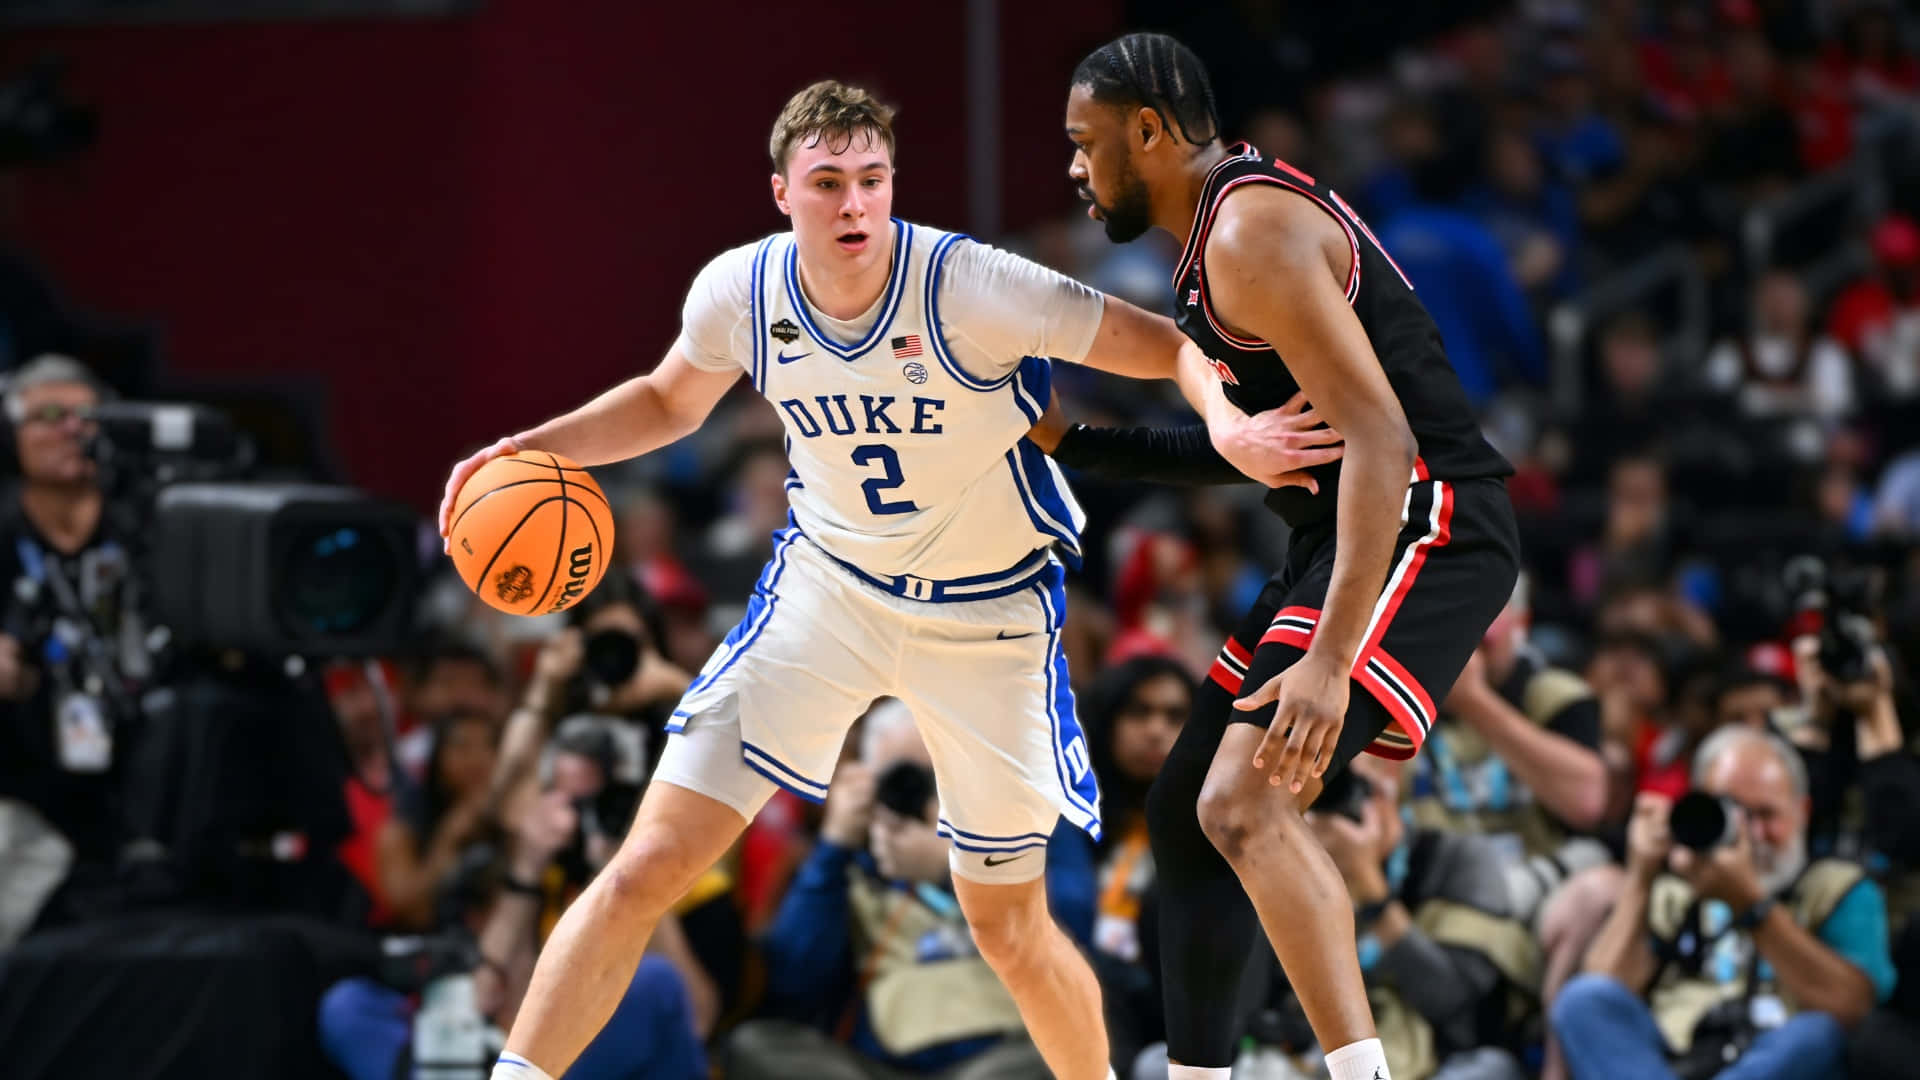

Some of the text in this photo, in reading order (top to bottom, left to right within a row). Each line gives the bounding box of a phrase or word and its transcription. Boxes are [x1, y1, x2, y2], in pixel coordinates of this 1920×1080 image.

[779, 394, 945, 438] DUKE
[850, 444, 920, 515] 2
[902, 575, 934, 601] D
